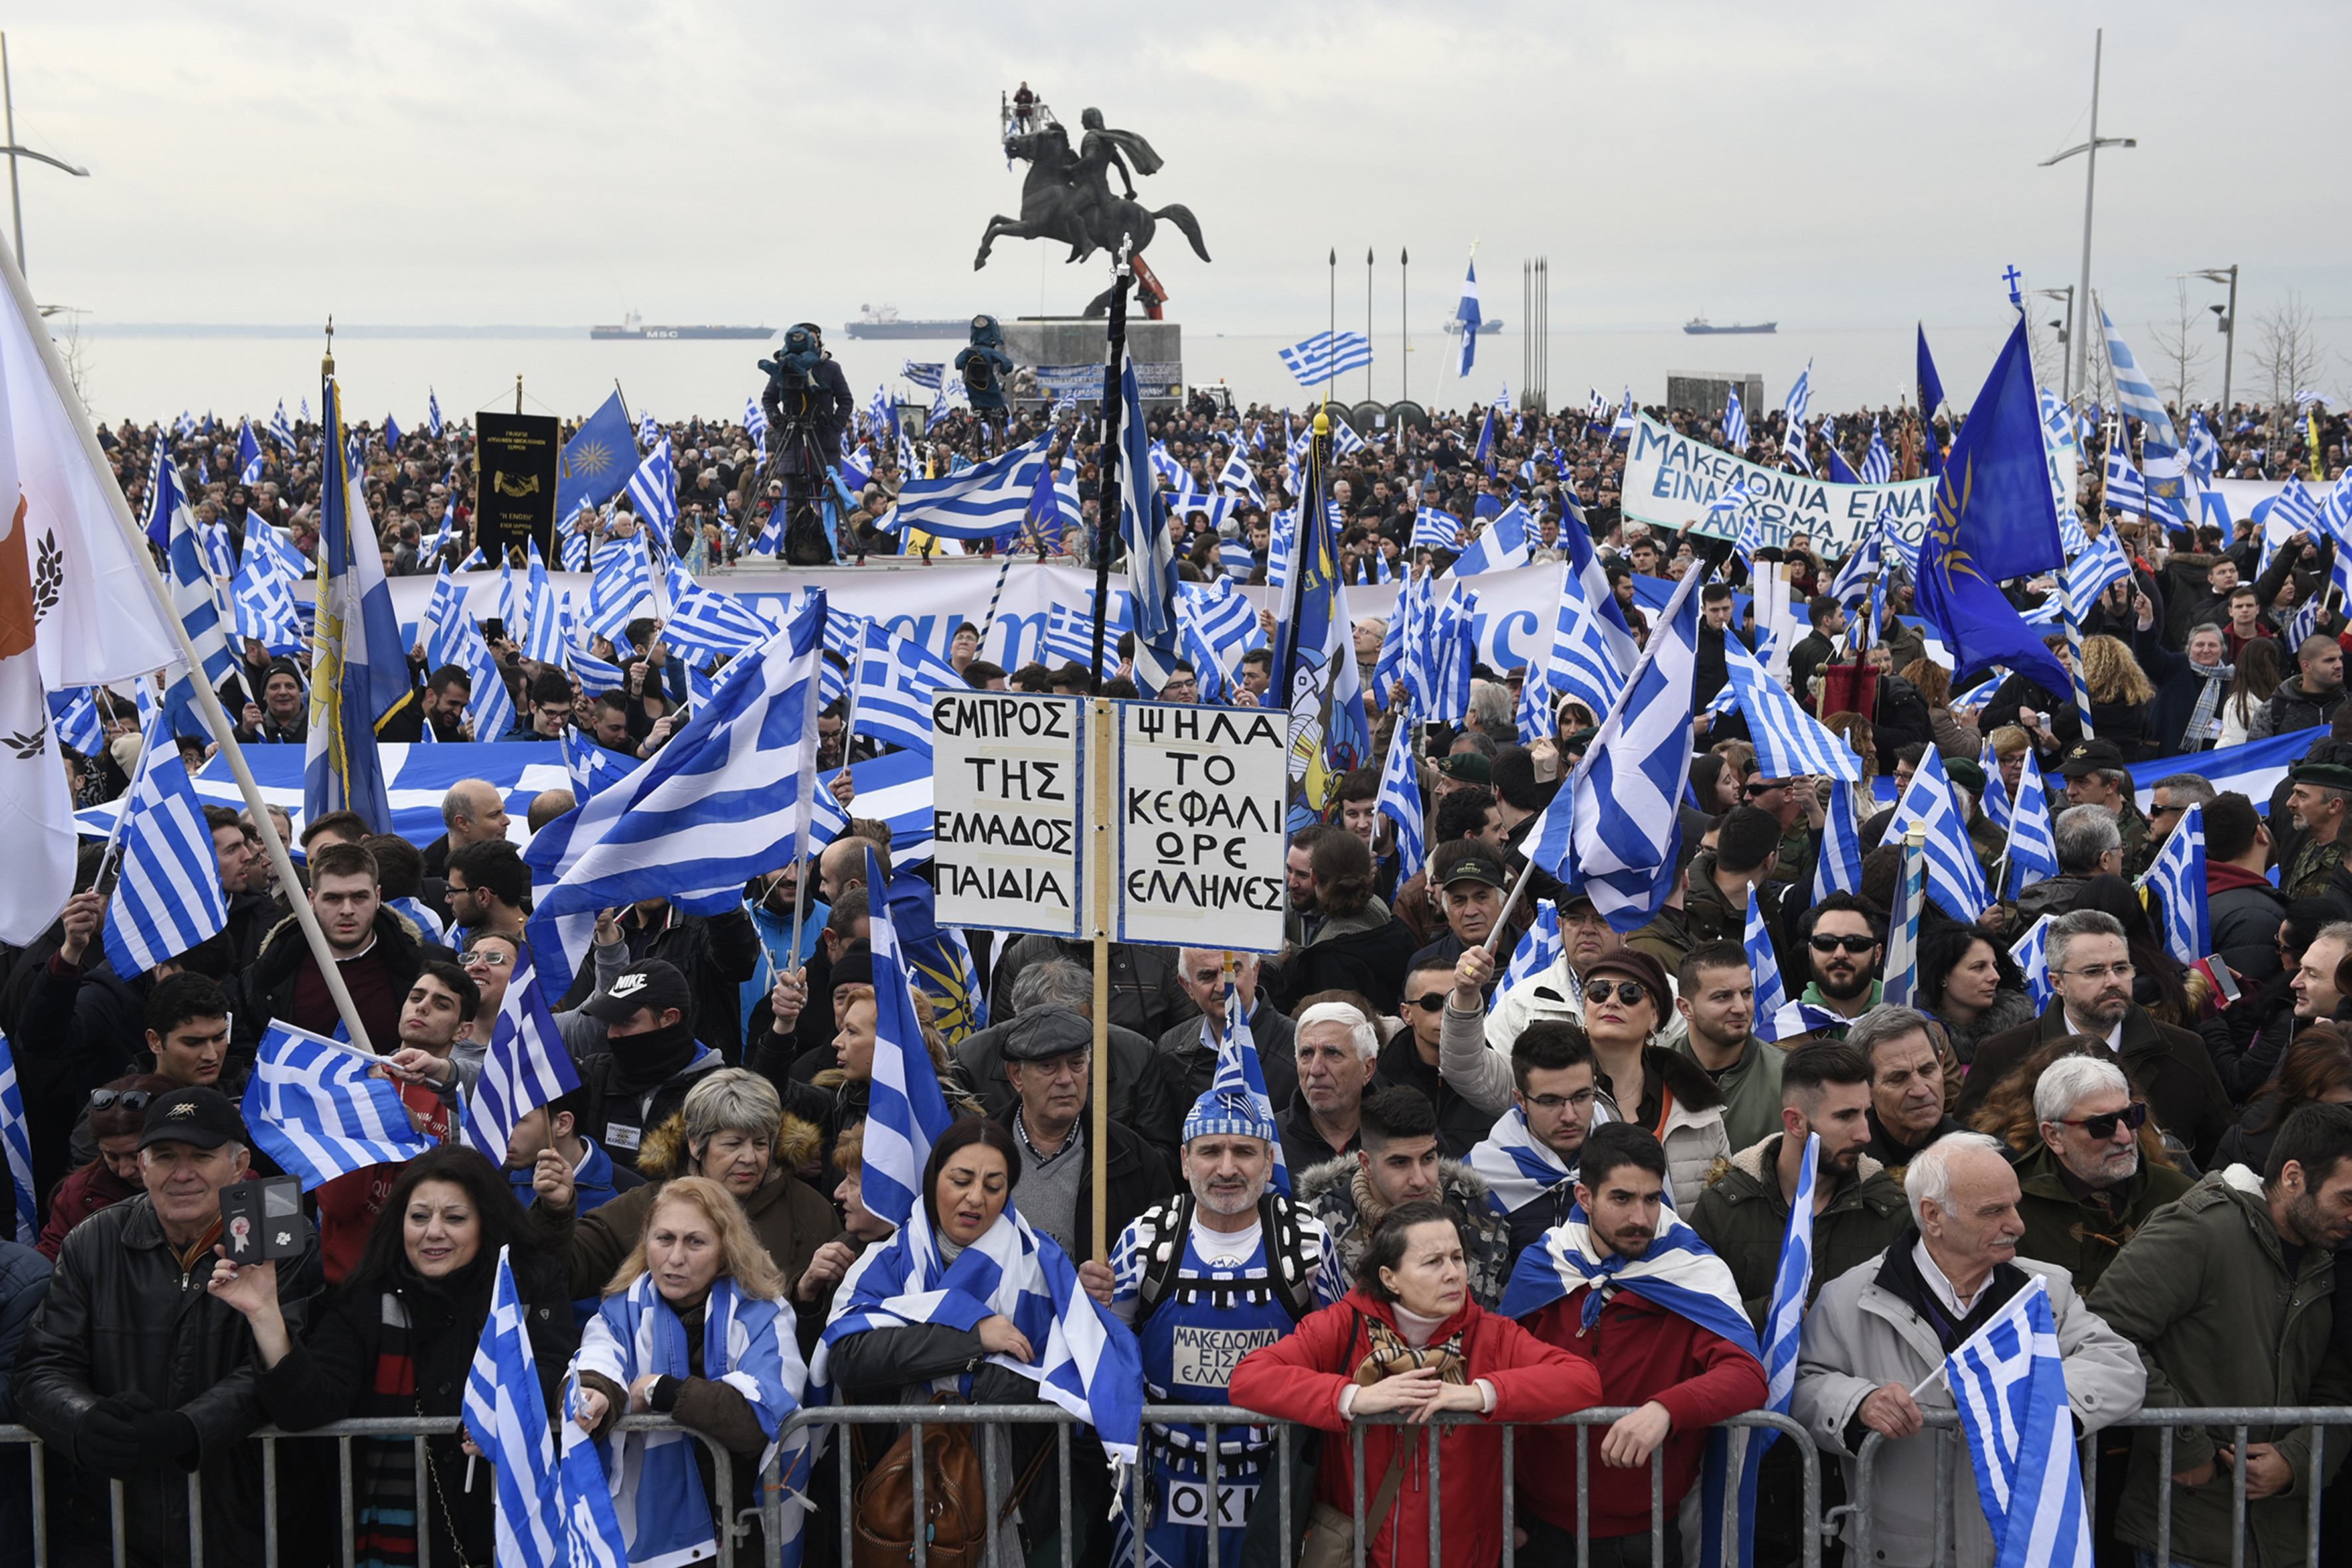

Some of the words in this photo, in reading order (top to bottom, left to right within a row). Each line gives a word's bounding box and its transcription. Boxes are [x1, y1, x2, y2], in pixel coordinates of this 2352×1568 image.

[1634, 422, 1828, 514] ΜΑΚΕΔΟΝΙΑ
[1847, 482, 1935, 518] ΕΙΝΑΙ
[933, 696, 1069, 739] ΕΜΠΡΟΣ
[1138, 708, 1284, 749] ΨΗΛΑ
[965, 757, 1065, 801] ΤΗΣ
[1166, 751, 1235, 786] ΤΟ
[1129, 787, 1281, 834] ΚΕΦΑΛΙ
[934, 810, 1073, 856] ΕΛΛΑΔΟΣ
[1156, 831, 1247, 870] ΩΡΕ
[935, 863, 1069, 908] ΠΑΙΔΙΑ
[1127, 869, 1283, 912] ΕΛΛΗΝΕΣ
[615, 973, 647, 990] NIKE
[1174, 1328, 1276, 1350] ΜΑΚΕΔΟΝΙΑ
[1199, 1349, 1247, 1368] ΕΙΣΑ
